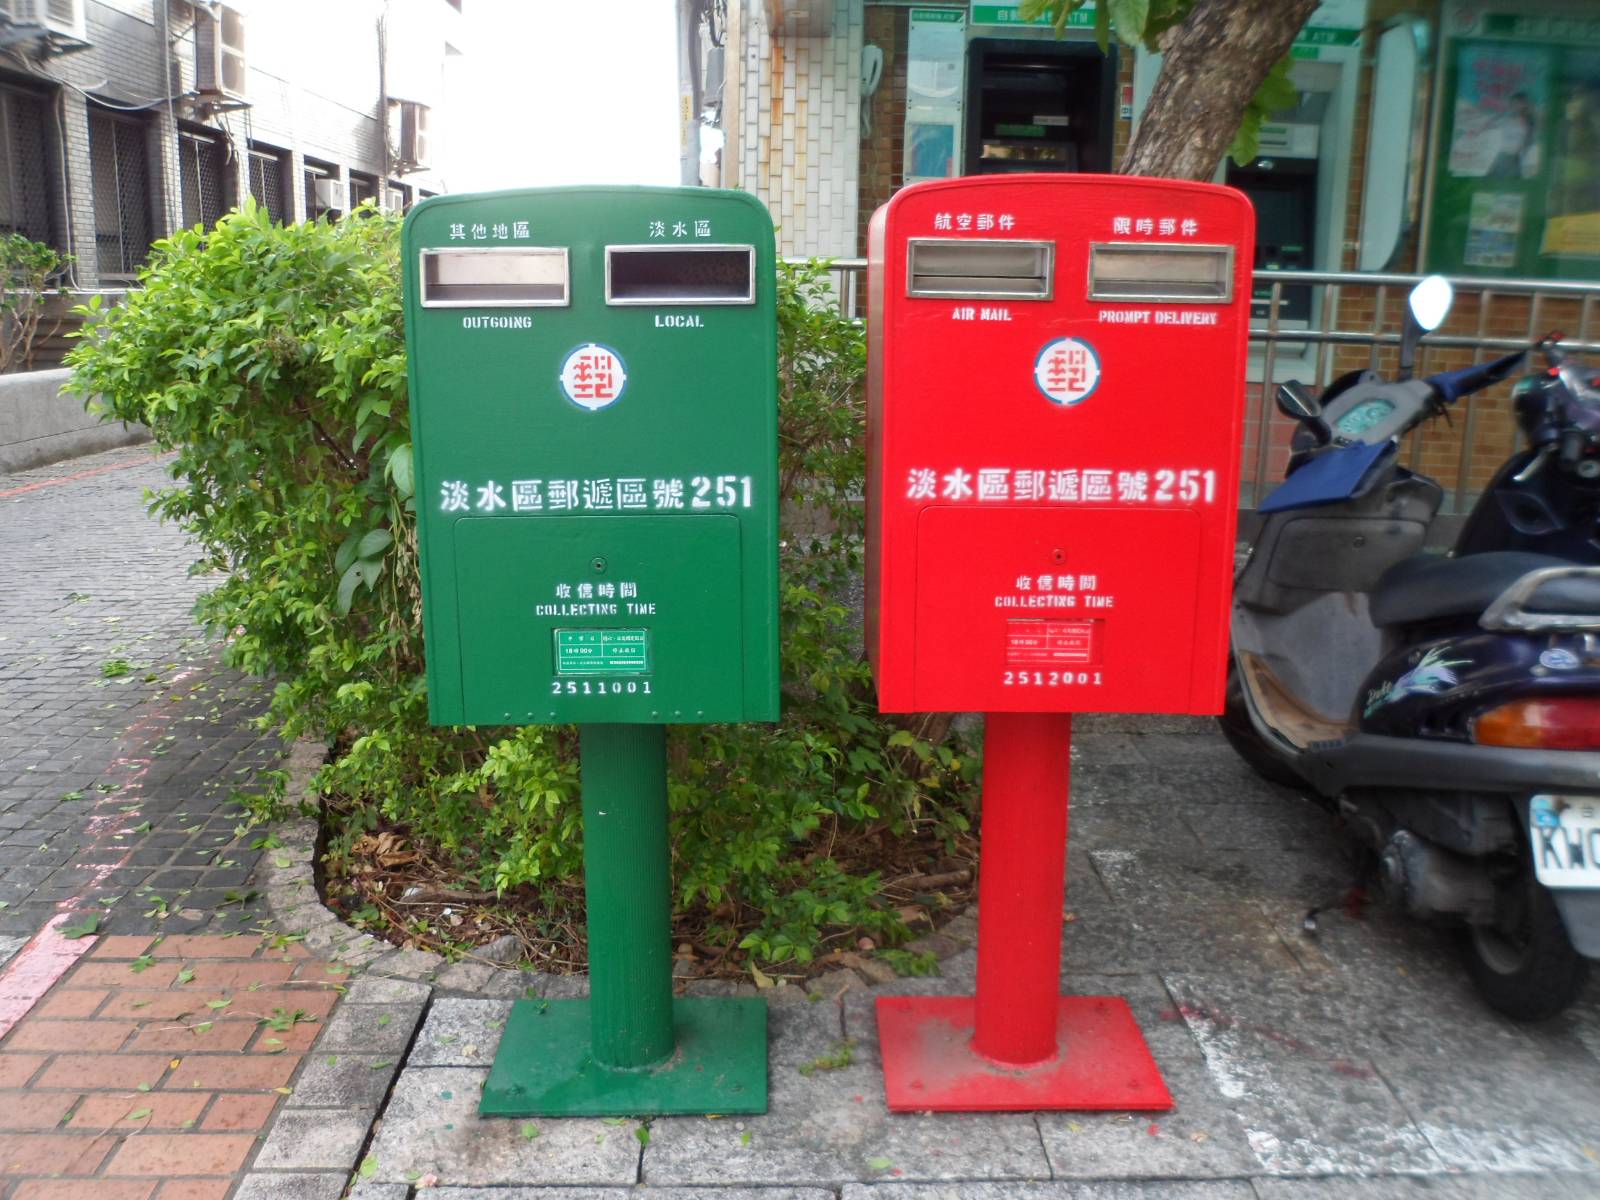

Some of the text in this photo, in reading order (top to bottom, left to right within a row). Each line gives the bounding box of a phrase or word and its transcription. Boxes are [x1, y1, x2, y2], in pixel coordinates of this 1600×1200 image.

[649, 220, 711, 239] 淡水區
[935, 213, 1015, 231] 航空郵件
[1113, 217, 1198, 236] 限時郵件
[450, 221, 530, 240] 其他地區
[655, 314, 705, 328] LOCAL
[952, 306, 1012, 322] AIR MAIL
[1099, 310, 1218, 326] PROMPT DELIVERY
[463, 315, 533, 330] OUTGOING
[556, 582, 637, 599] 收信時間
[1016, 575, 1097, 591] 收信時間
[536, 603, 656, 616] COLLECTING TIME
[995, 596, 1114, 609] COLLECTING TIME
[1003, 671, 1102, 686] 2512001
[552, 681, 652, 695] 2511001
